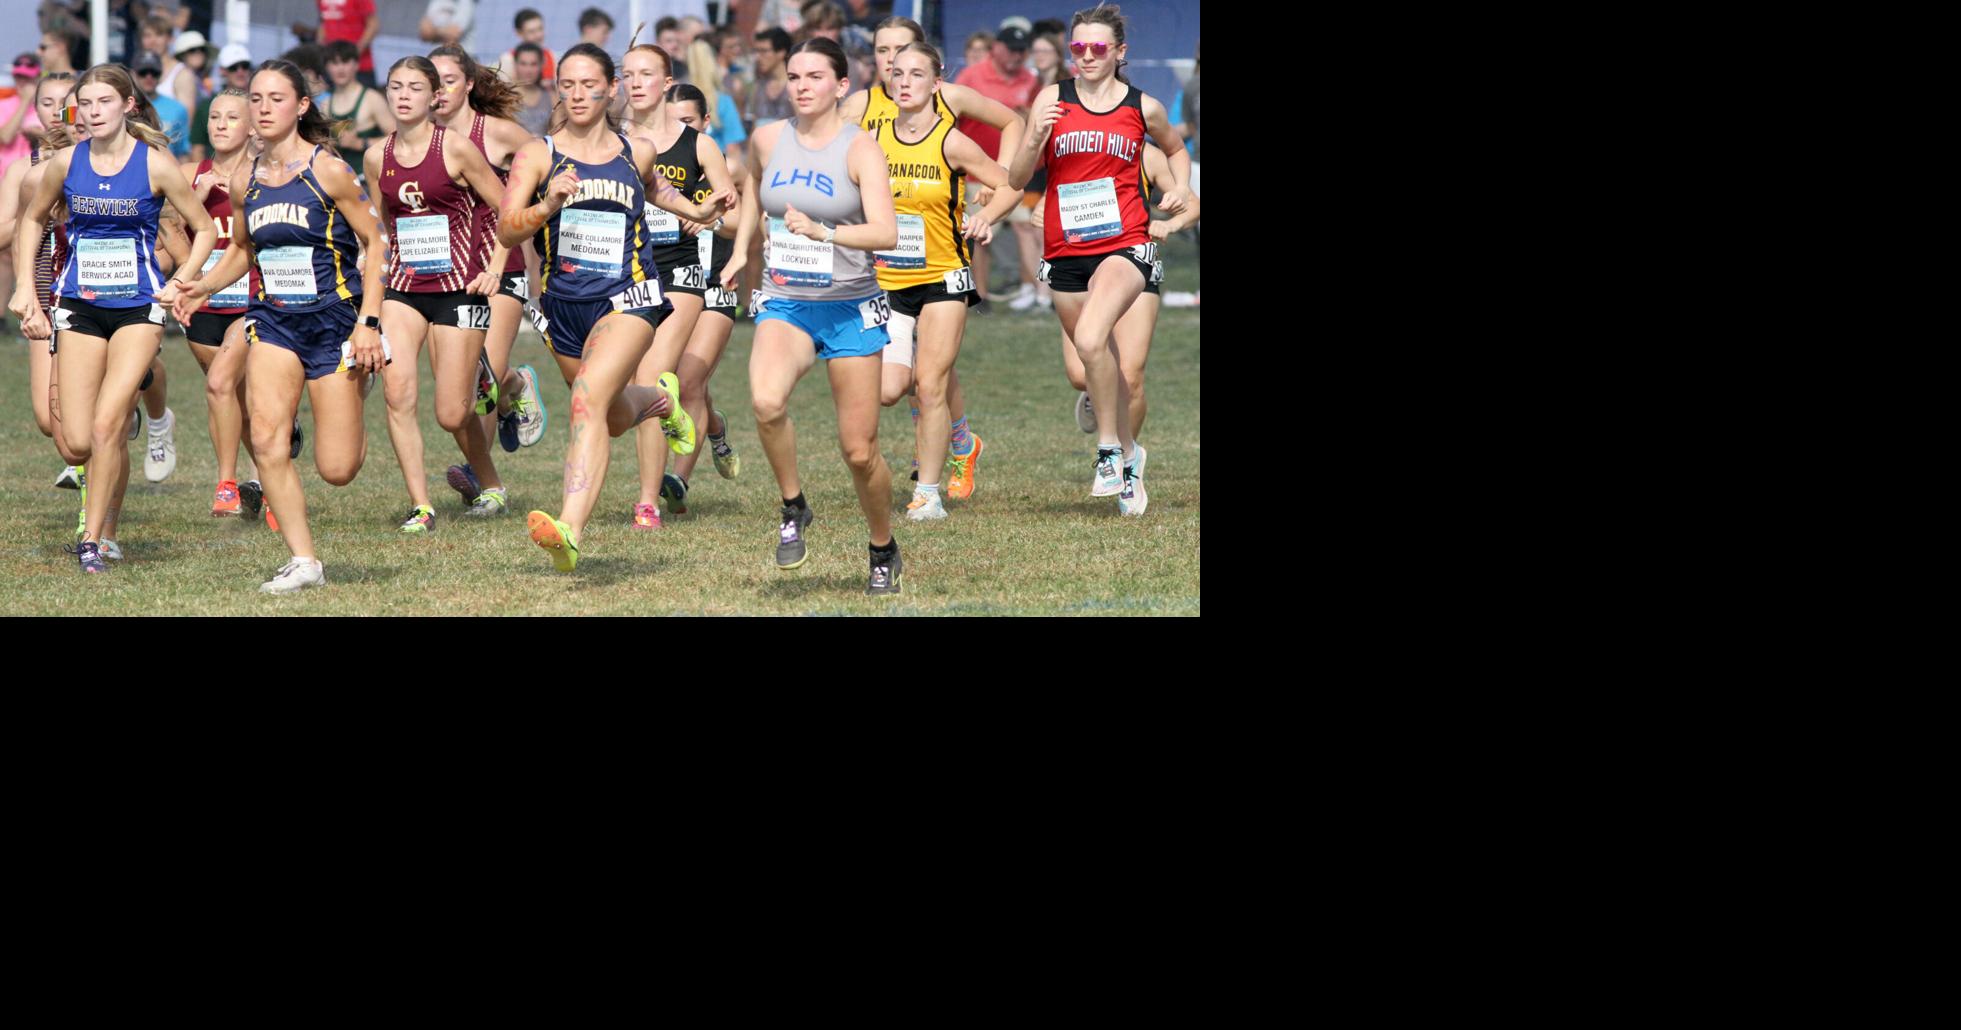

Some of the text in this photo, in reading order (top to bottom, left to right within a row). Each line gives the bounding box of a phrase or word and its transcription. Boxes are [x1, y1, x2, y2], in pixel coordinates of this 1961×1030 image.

[1054, 130, 1138, 163] CAMDEN HILLS
[653, 164, 687, 181] OOD
[887, 163, 942, 180] RANACOOK
[770, 168, 834, 197] LHS
[71, 194, 138, 217] BERWICK
[1061, 198, 1116, 213] MADDY ST CHARLES
[646, 219, 667, 227] WOOD
[1074, 211, 1105, 223] CAMDEN
[399, 235, 448, 246] AVERY PALMORE
[560, 230, 623, 244] KAYLEE COLLAMORE
[899, 234, 924, 242] HARPER
[400, 246, 449, 256] CAPE ELIZABETH
[570, 243, 611, 256] MEDOMAK
[771, 241, 832, 253] ANNA CARRUTHERS
[82, 260, 132, 269] GRACIE SMITH
[781, 253, 819, 265] LOCKVIEW
[81, 270, 134, 280] BERWICK ACAD
[264, 268, 313, 276] AVA COLLAMORE
[274, 279, 306, 288] MEDOMAK
[953, 268, 976, 292] 37
[623, 280, 652, 309] 404
[467, 305, 491, 328] 122
[869, 296, 892, 325] 35
